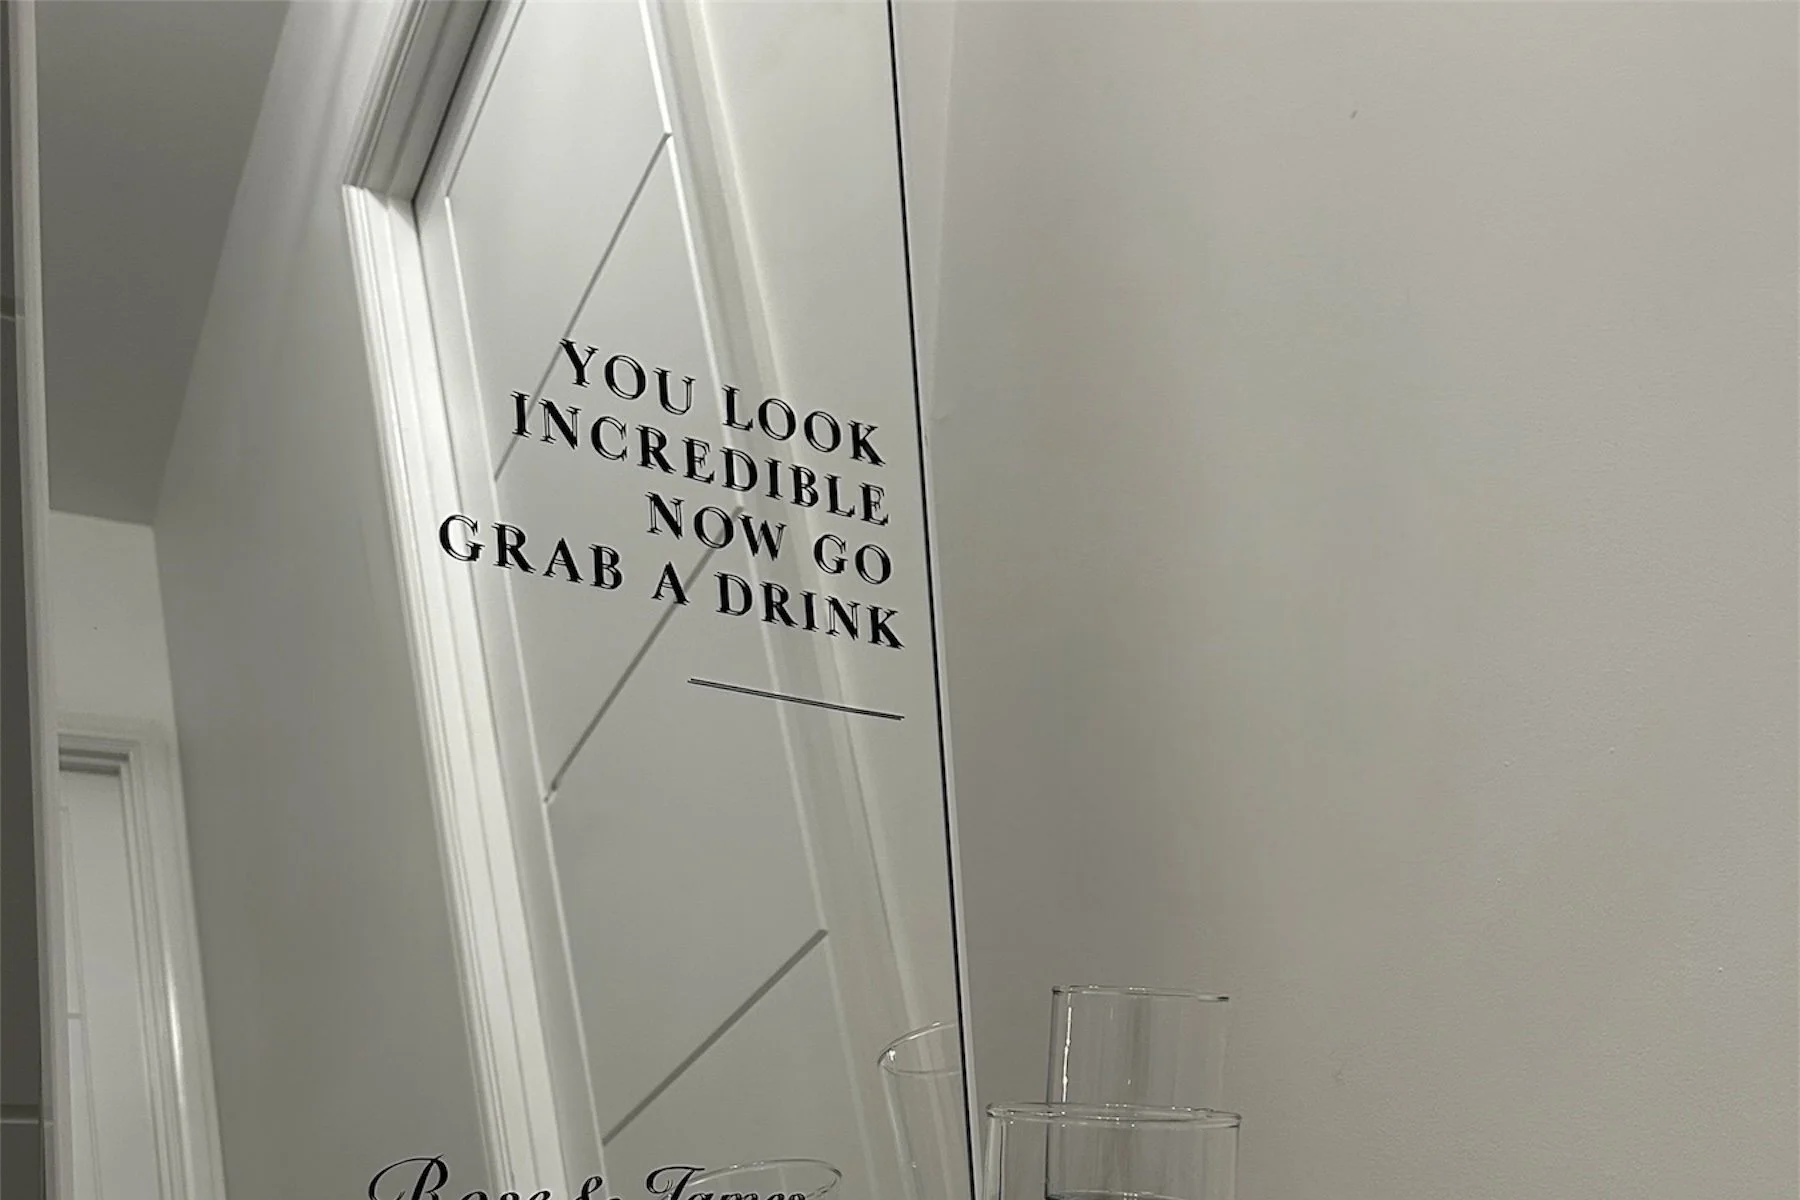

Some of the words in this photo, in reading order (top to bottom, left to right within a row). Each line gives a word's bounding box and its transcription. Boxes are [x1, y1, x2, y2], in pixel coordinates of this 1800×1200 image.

[510, 391, 889, 527] INCREDIBLE
[560, 338, 695, 416] YOU
[722, 385, 886, 467] LOOK
[439, 514, 623, 590] GRAB
[652, 561, 689, 605] A
[714, 571, 905, 649] DRINK
[646, 491, 787, 561] NOW
[813, 534, 891, 585] GO
